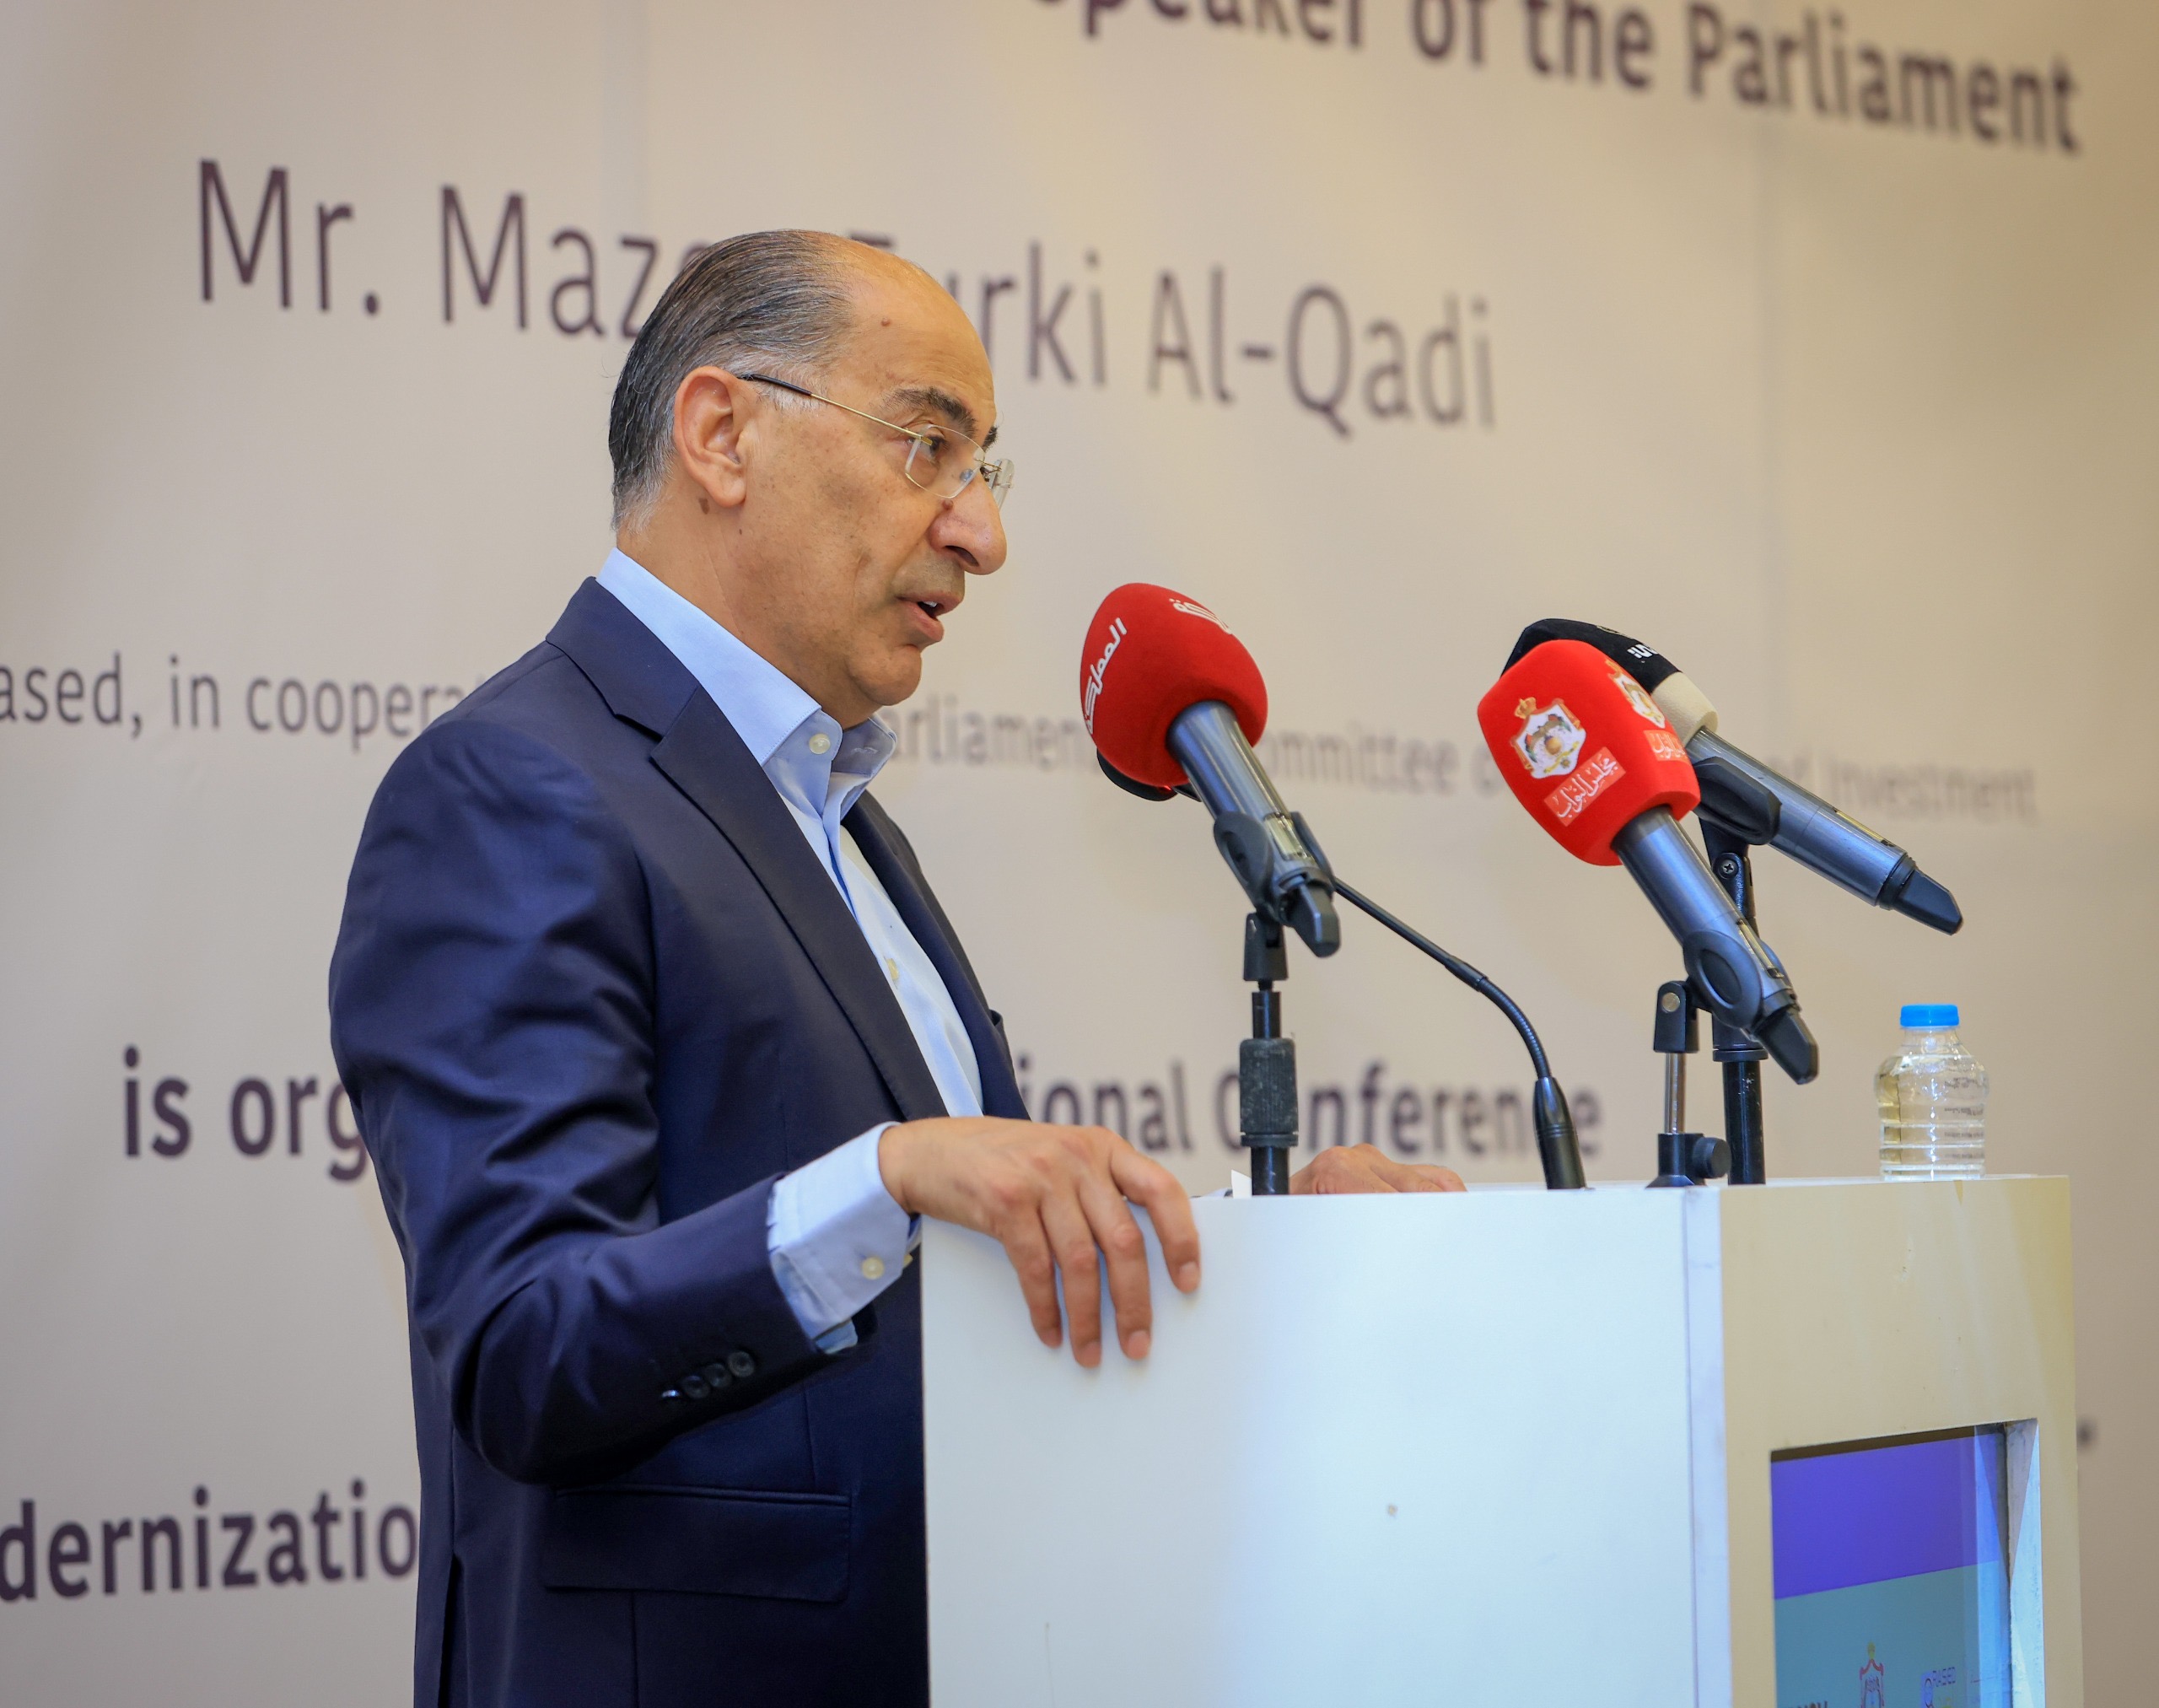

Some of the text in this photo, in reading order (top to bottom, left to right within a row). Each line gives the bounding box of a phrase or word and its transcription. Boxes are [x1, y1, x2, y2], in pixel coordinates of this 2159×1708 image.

[1523, 0, 1655, 89] the
[1687, 3, 2078, 154] Parliament
[199, 159, 1496, 438] Mr. Maz rki Al-Qadi
[0, 651, 143, 740] ased,
[169, 655, 220, 729] in
[245, 675, 482, 753] cooper
[125, 1045, 191, 1157] is
[1216, 1060, 1607, 1160] Cnferene
